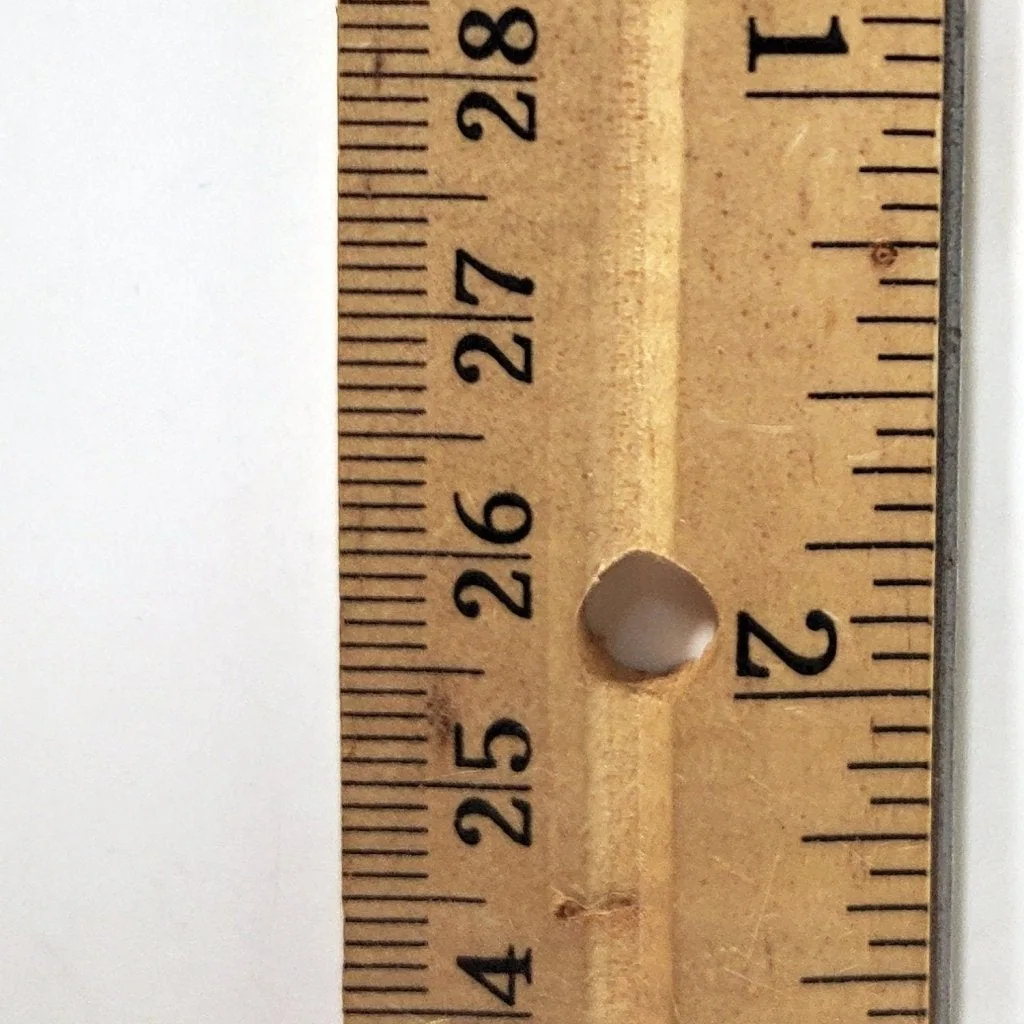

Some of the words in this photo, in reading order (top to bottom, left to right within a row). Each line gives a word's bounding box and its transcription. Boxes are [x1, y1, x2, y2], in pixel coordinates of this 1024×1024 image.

[456, 6, 538, 142] 28
[747, 14, 850, 74] 1
[453, 248, 535, 384] 27
[453, 490, 533, 620] 26
[735, 609, 838, 679] 2
[453, 717, 533, 848] 25
